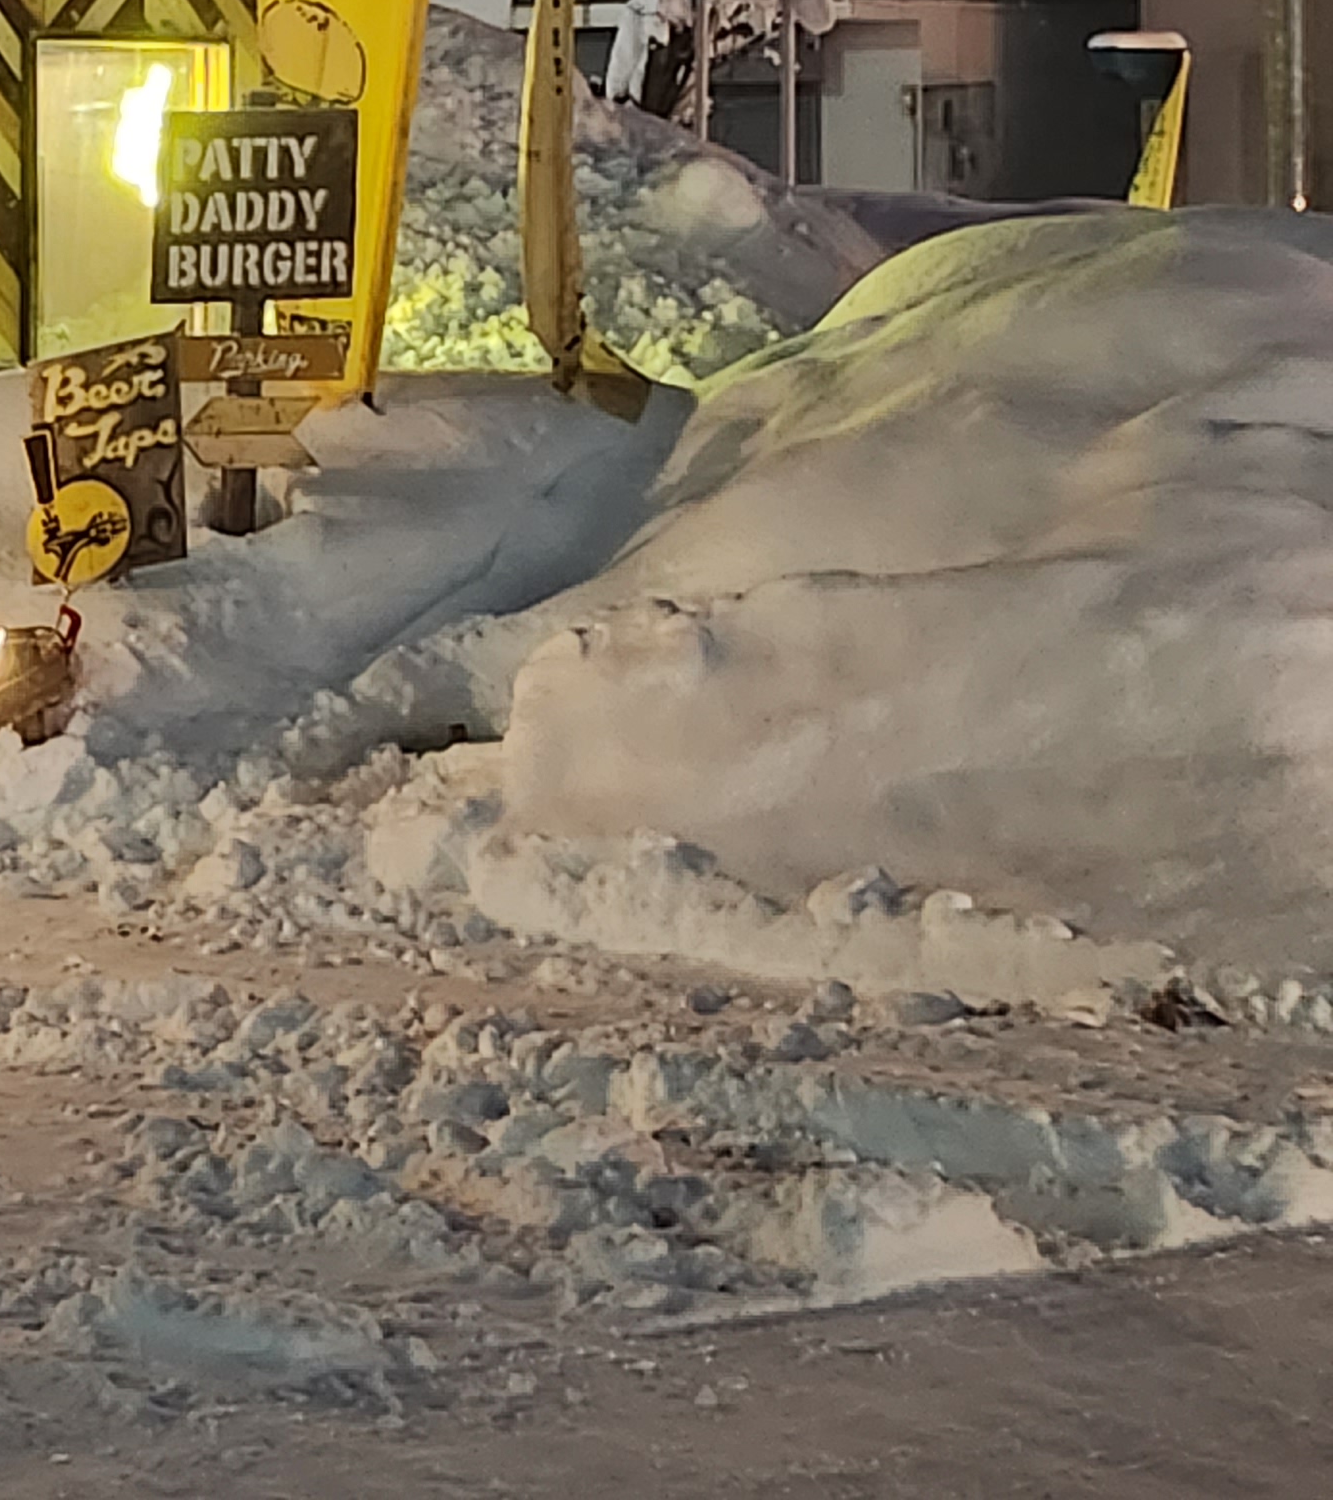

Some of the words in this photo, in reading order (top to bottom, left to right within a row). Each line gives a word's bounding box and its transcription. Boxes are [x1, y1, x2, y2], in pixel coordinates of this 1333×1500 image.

[172, 135, 318, 182] PATTY
[170, 188, 329, 235] DADDY
[167, 241, 349, 288] BURGER
[64, 411, 179, 469] Taps
